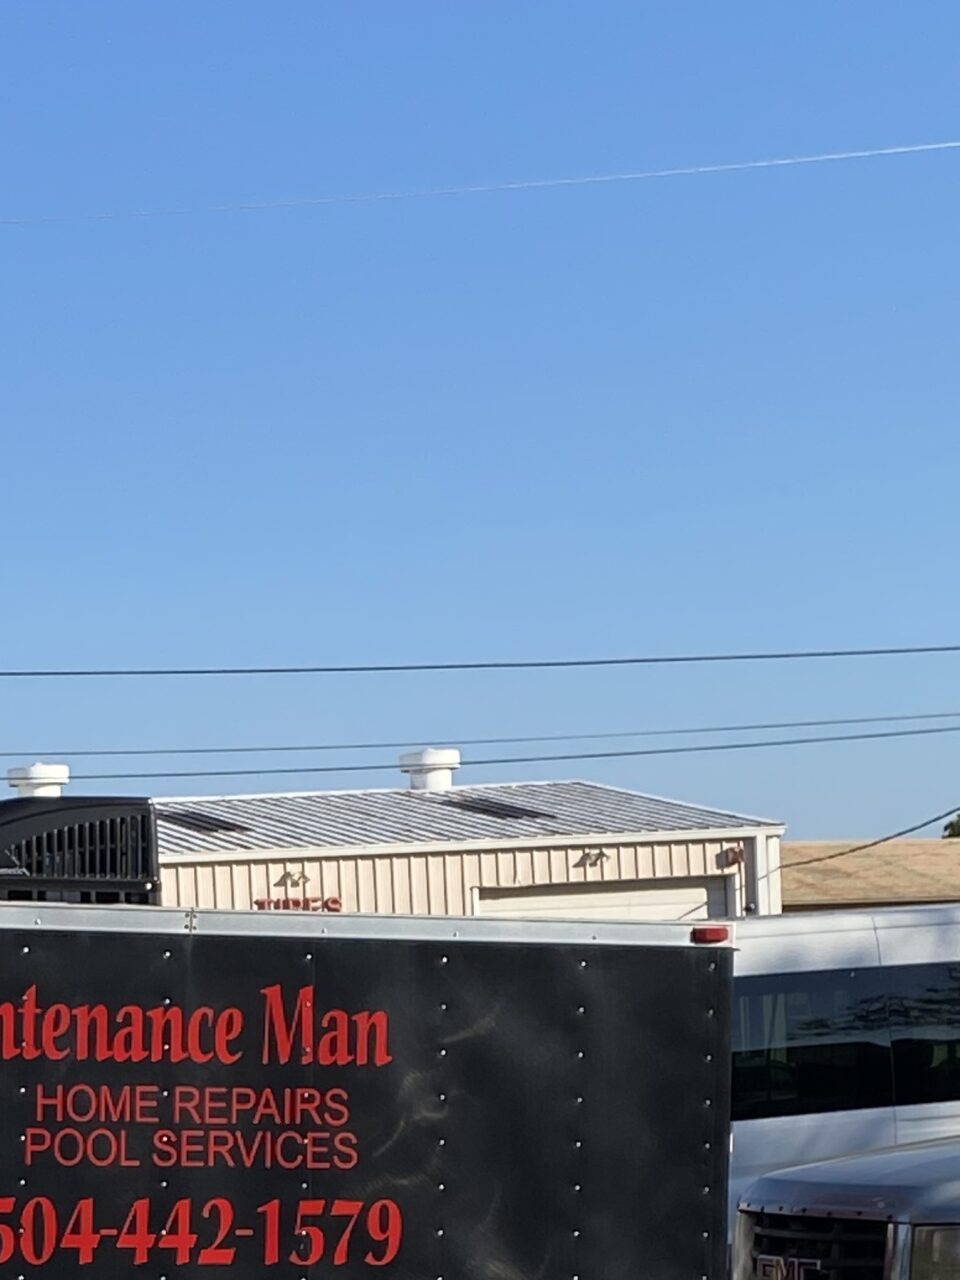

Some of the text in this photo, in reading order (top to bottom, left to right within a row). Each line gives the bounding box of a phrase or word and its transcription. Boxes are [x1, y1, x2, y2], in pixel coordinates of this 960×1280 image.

[261, 984, 392, 1066] Man
[35, 1083, 349, 1126] HOME REPAIRS
[24, 1127, 358, 1169] POOL SERVICES
